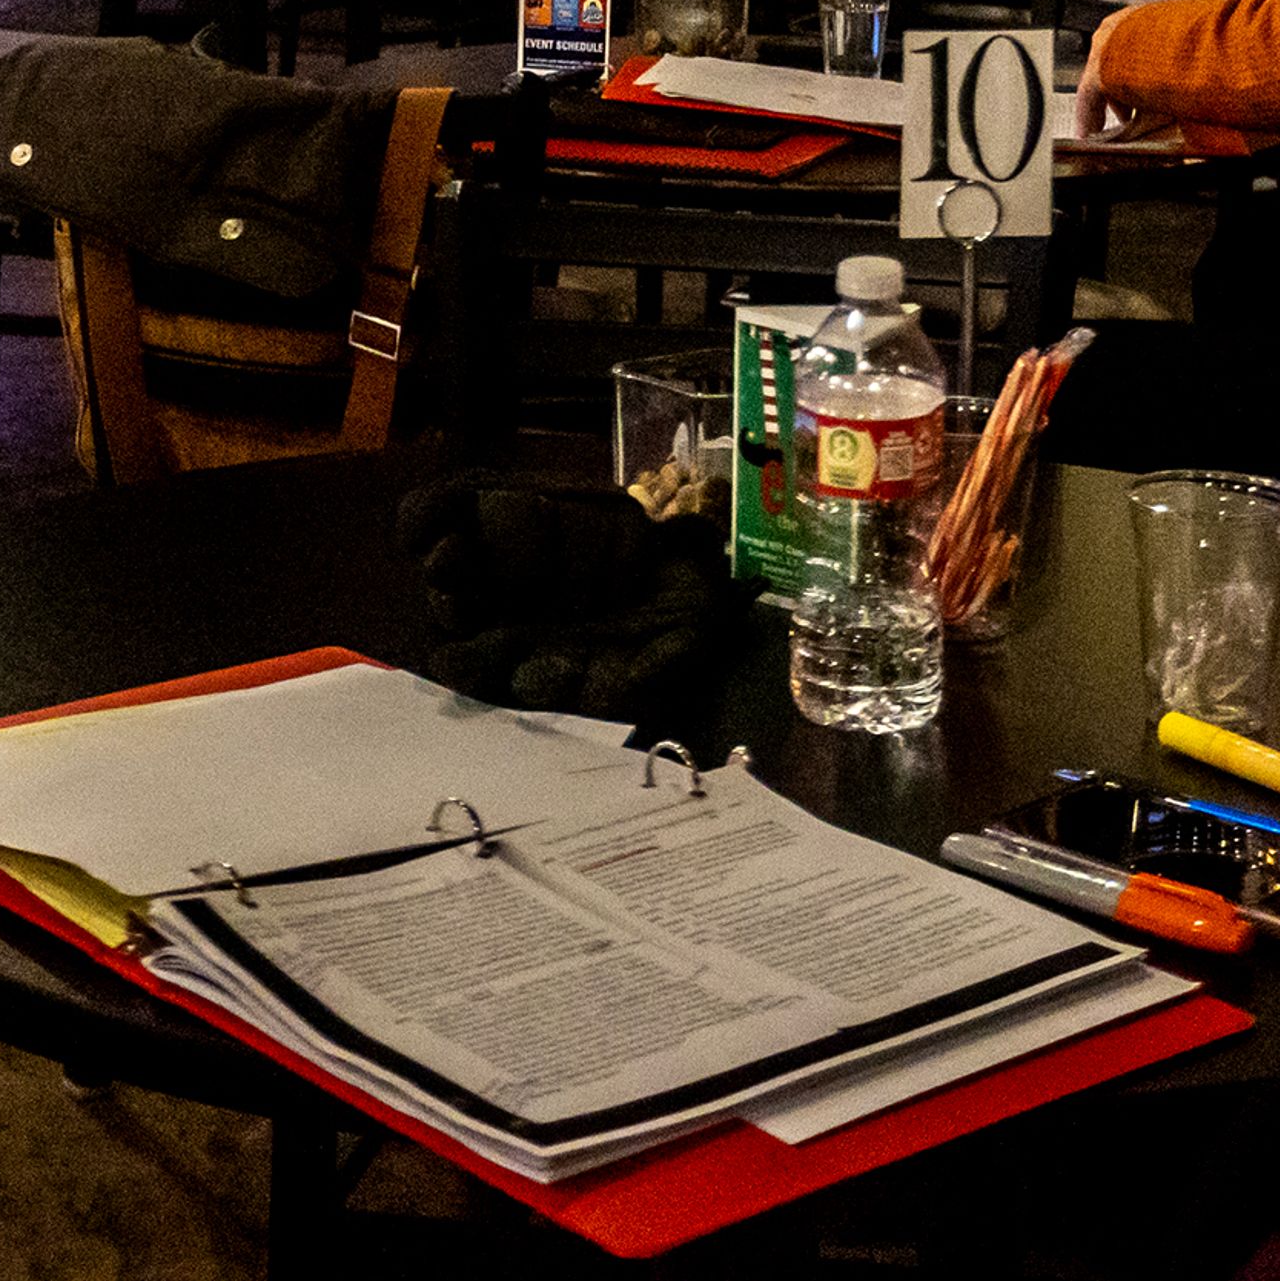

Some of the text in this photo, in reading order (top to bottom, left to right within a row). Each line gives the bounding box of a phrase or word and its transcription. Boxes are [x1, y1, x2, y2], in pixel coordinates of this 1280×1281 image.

[525, 37, 605, 54] EVENT SCHEDULE
[909, 34, 1046, 184] 10
